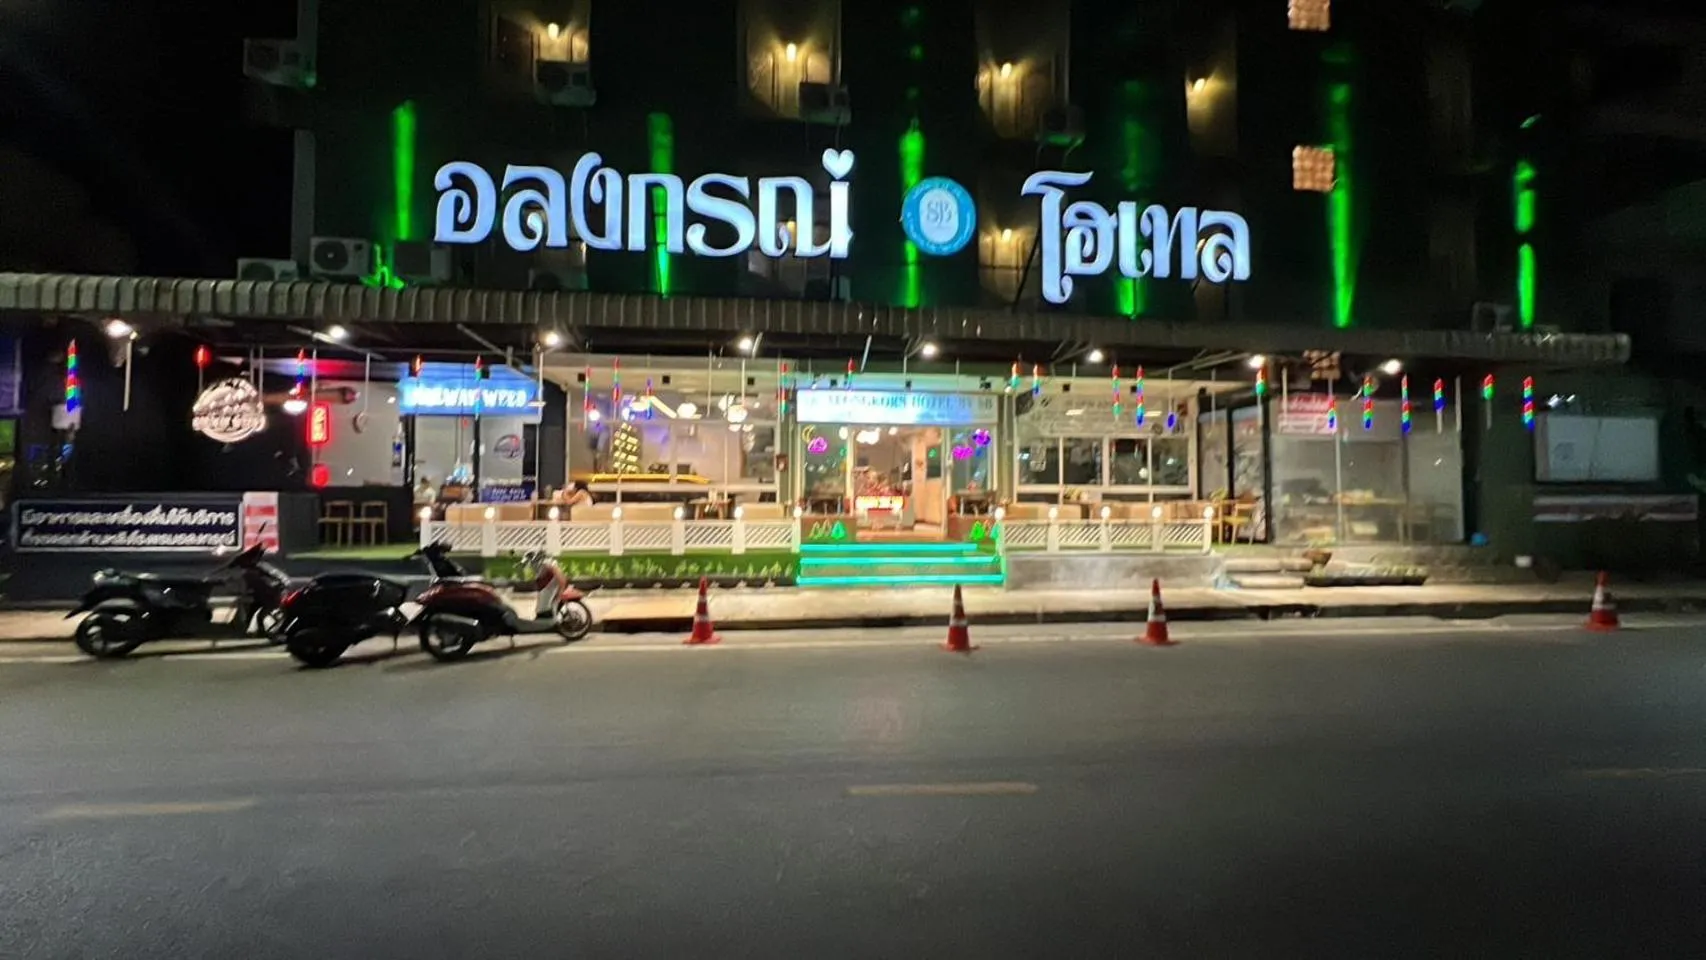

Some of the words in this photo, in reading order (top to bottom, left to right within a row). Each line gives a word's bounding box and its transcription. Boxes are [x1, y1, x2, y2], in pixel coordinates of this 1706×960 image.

[434, 148, 855, 262] อลงกรณ์
[1022, 170, 1252, 304] โฮเทล
